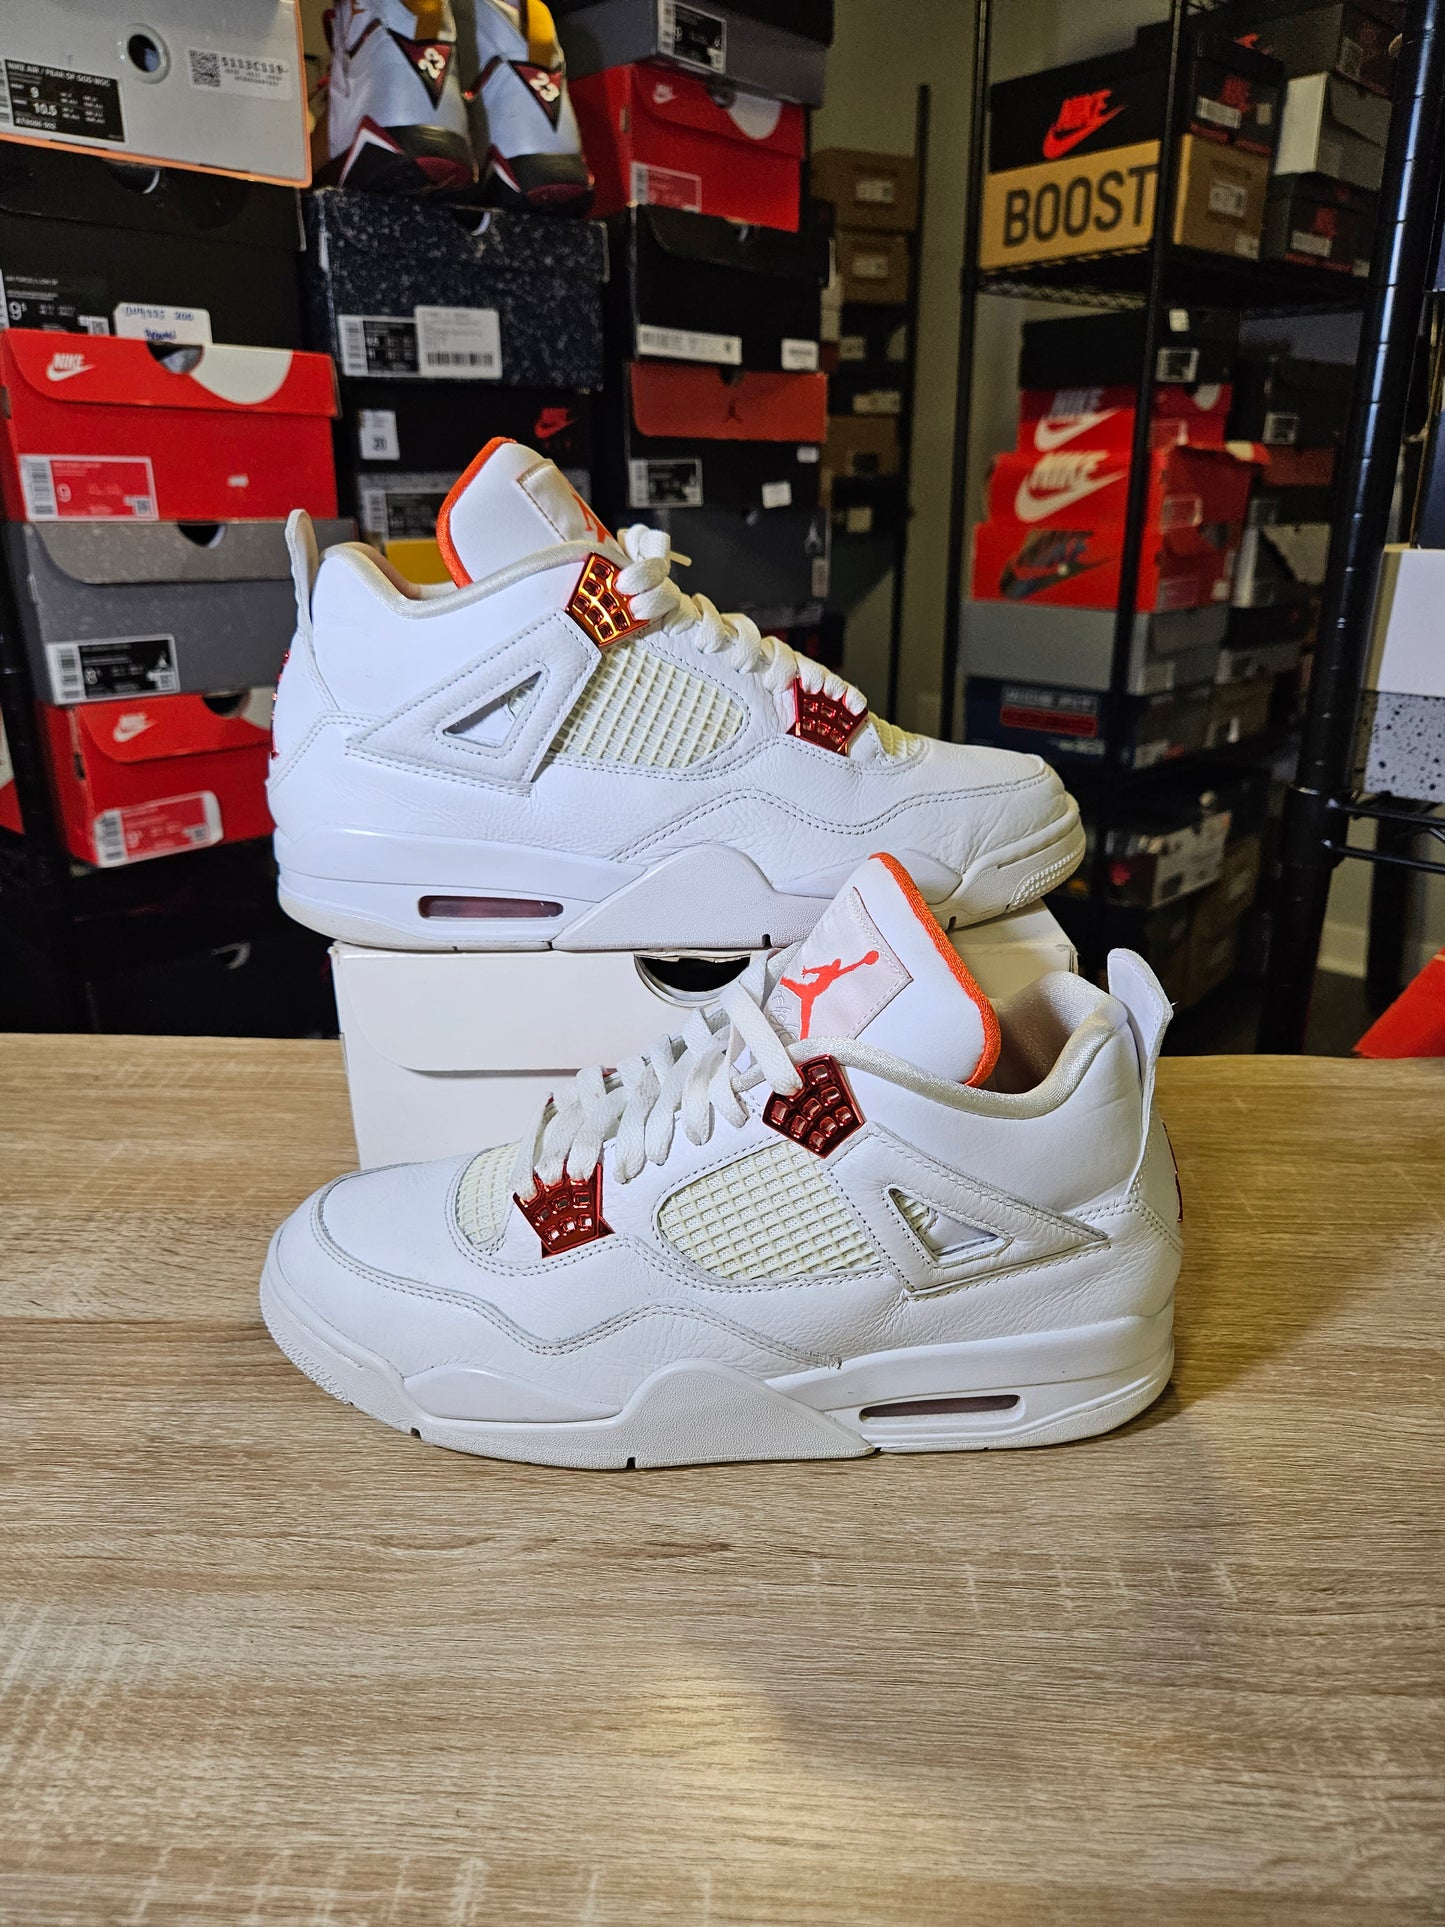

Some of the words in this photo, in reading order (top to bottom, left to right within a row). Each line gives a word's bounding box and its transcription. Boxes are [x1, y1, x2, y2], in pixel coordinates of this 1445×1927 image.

[418, 47, 446, 80] 23
[30, 86, 40, 98] 9
[528, 71, 561, 102] 23
[1003, 164, 1160, 247] BOOST
[53, 352, 85, 370] NIKE
[56, 483, 72, 503] 9
